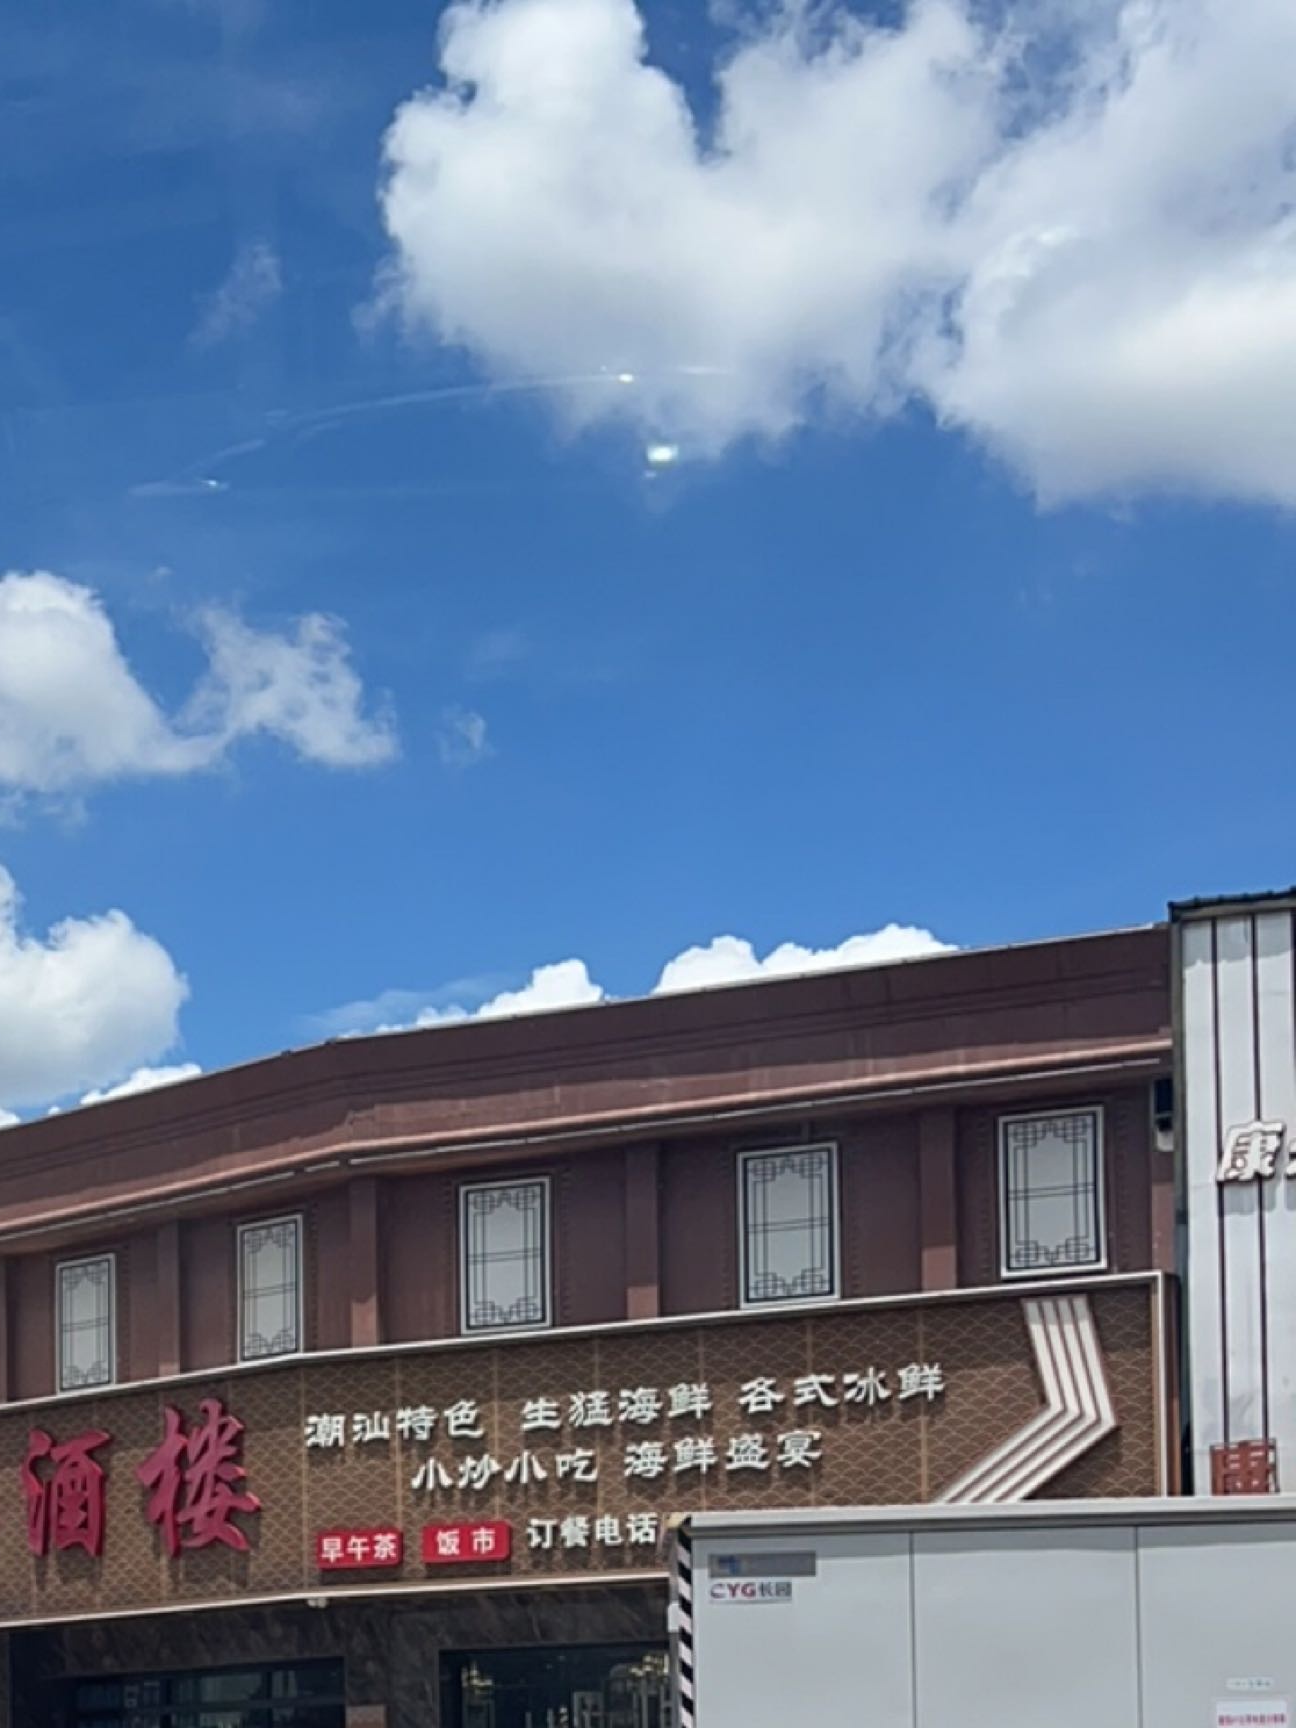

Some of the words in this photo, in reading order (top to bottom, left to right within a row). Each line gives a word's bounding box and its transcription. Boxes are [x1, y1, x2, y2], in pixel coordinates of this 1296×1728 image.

[1216, 1121, 1296, 1182] 康
[306, 1399, 484, 1447] 潮汕特色
[521, 1383, 712, 1434] 生猛海鲜
[739, 1363, 946, 1414] 各式冰鲜
[410, 1447, 598, 1491] 小炒小吃
[623, 1430, 823, 1478] 海鲜盛宴
[321, 1532, 398, 1563] 早午茶
[436, 1528, 496, 1556] 饭市
[526, 1511, 658, 1550] 订餐电话
